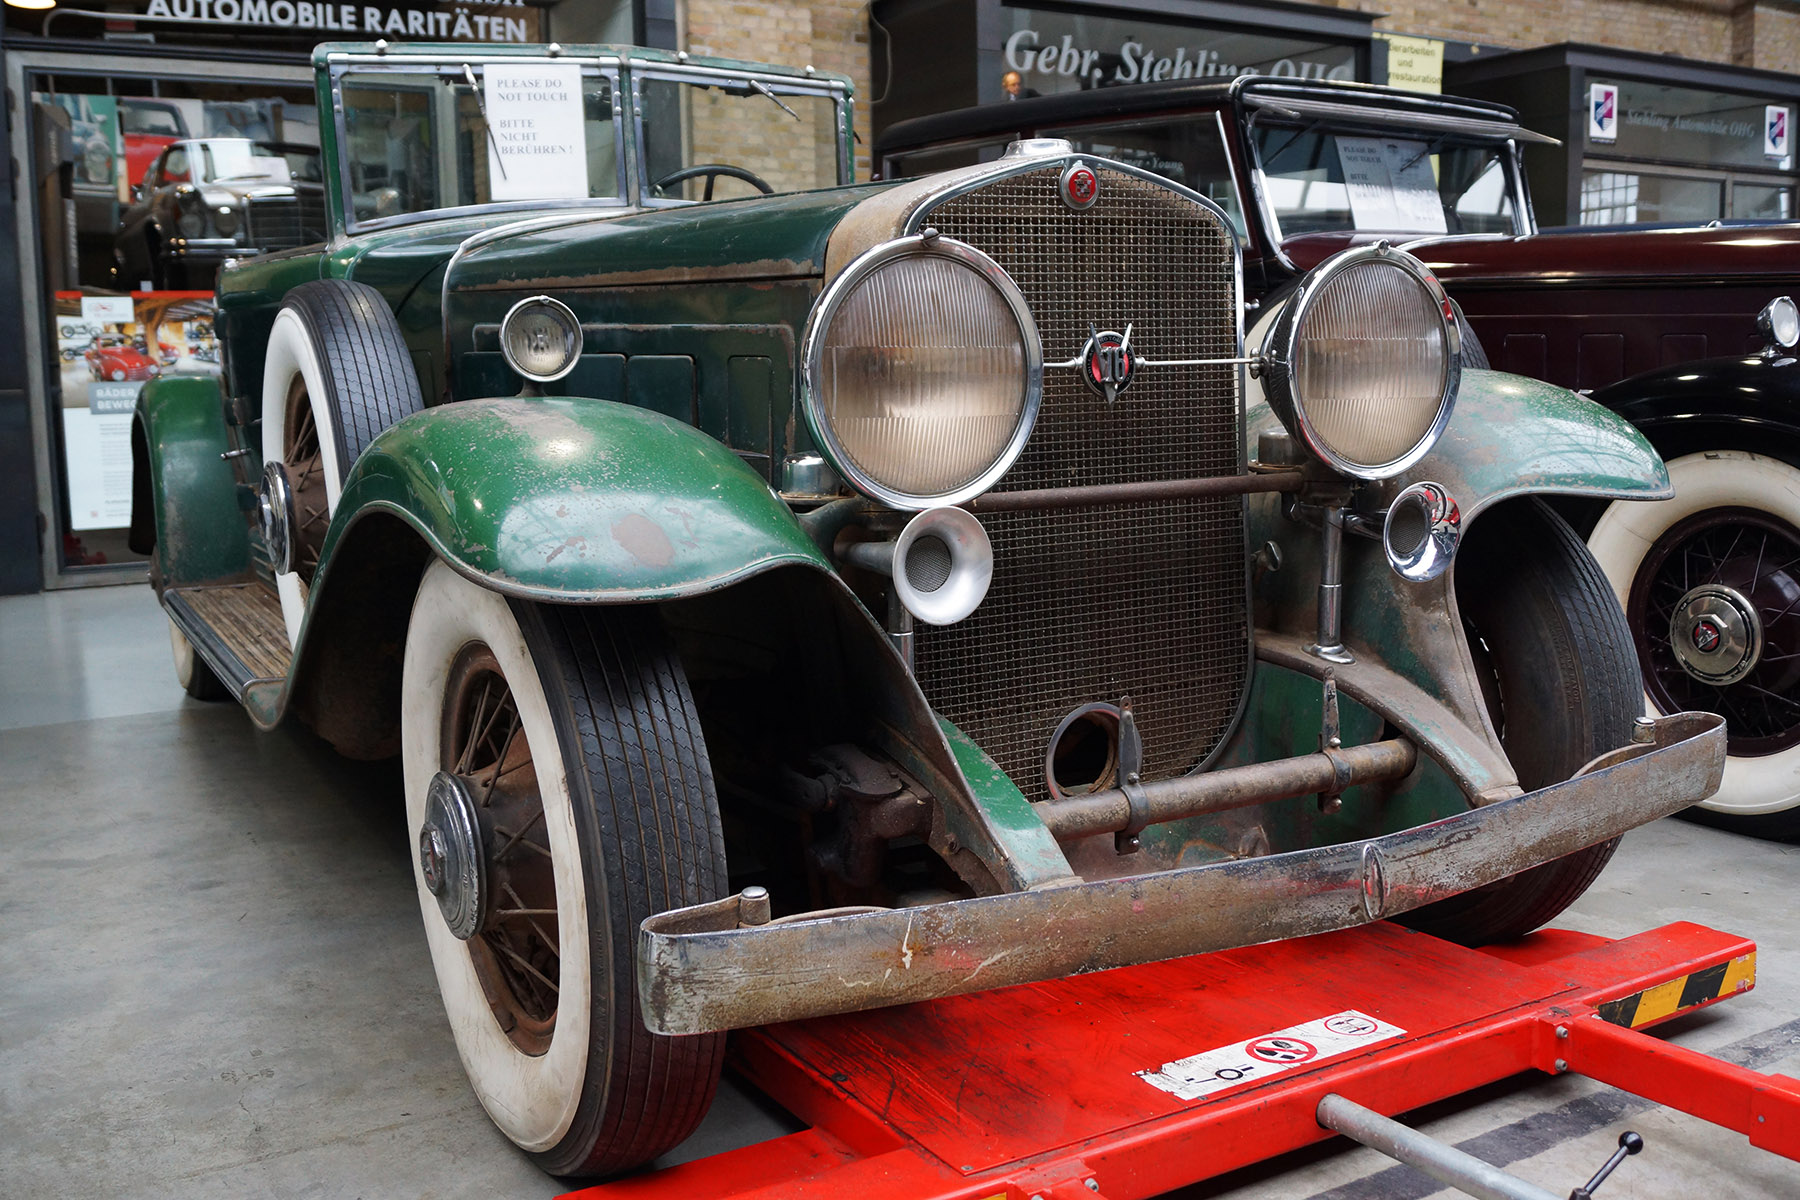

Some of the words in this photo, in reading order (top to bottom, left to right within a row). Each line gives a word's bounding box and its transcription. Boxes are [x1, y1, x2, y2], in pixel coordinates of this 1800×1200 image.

[147, 0, 358, 29] AUTOMOBILE
[363, 6, 528, 42] RARITÄTEN
[1004, 29, 1103, 78] Gebr.
[1115, 41, 1257, 83] Stehli
[1397, 58, 1413, 68] und
[497, 79, 542, 89] PLEASE
[545, 79, 562, 88] DO
[498, 92, 522, 102] NOT
[526, 92, 568, 101] TOUCH
[500, 119, 535, 129] BITTE
[1626, 108, 1669, 132] Stehling
[1673, 115, 1729, 136] Automobile
[1729, 120, 1755, 138] OHG
[500, 132, 538, 142] NICHT
[501, 143, 566, 155] BERÜHREN
[1152, 157, 1184, 172] Young
